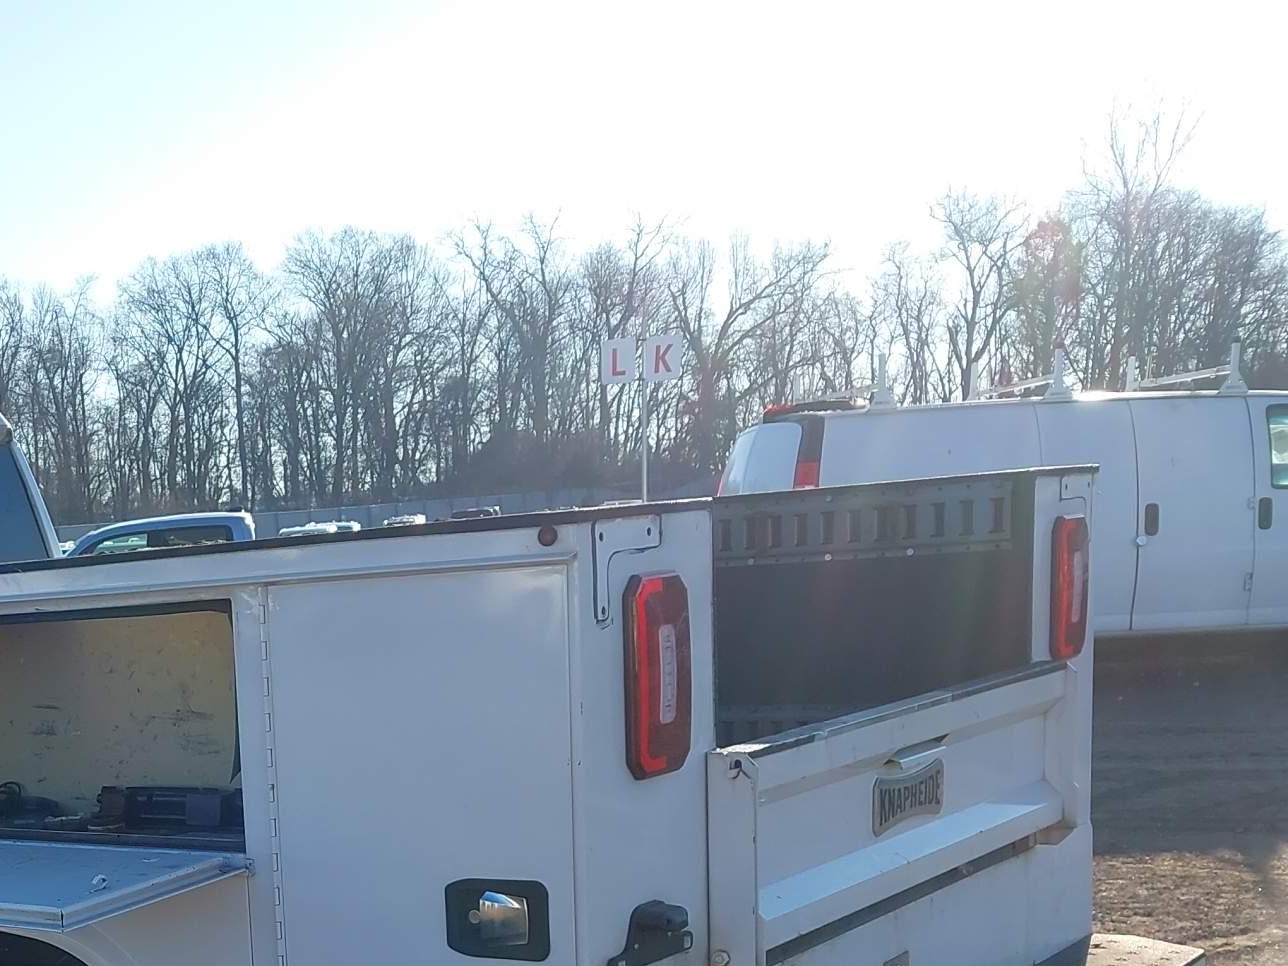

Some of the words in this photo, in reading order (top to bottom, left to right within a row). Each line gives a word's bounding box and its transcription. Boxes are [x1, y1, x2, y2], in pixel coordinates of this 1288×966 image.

[611, 348, 626, 377] L
[654, 343, 674, 374] K
[878, 769, 942, 827] KNAPHEIDE
